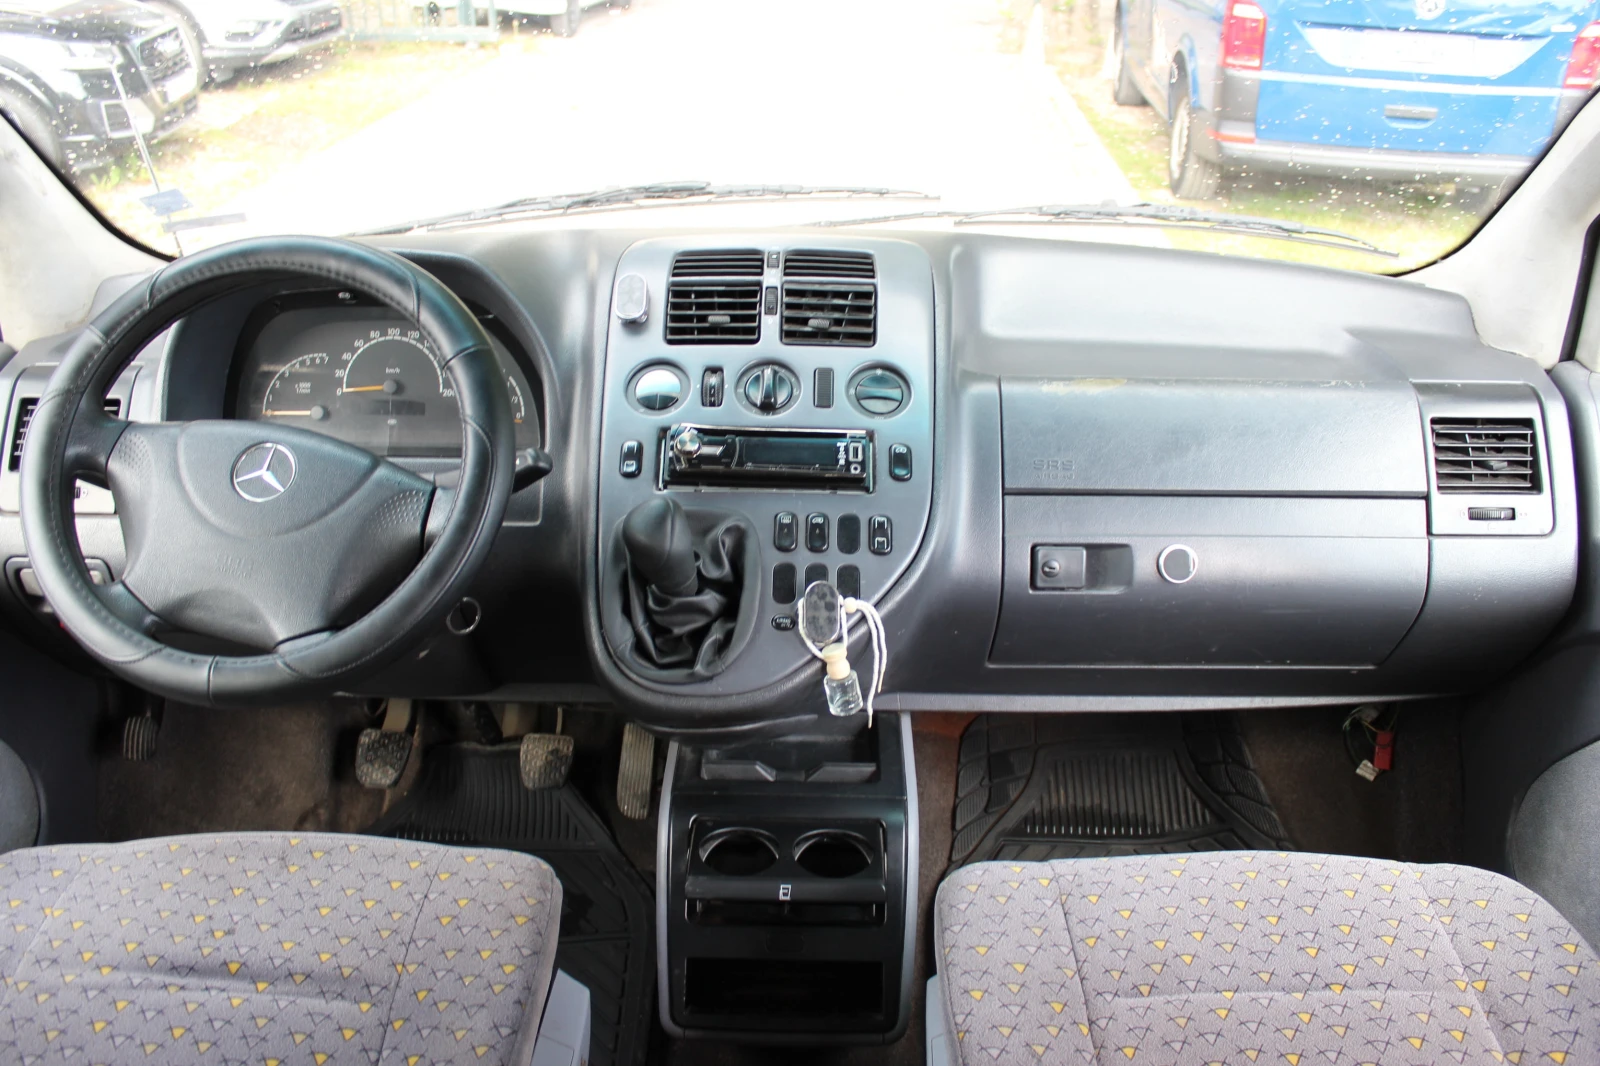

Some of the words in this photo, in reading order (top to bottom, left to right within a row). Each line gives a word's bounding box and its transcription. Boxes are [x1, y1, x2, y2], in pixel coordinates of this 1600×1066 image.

[370, 330, 380, 339] 80
[387, 327, 400, 336] 100
[407, 330, 420, 339] 120
[354, 338, 364, 348] 60
[315, 356, 321, 365] 6
[323, 356, 329, 365] 7
[341, 352, 352, 361] 40
[284, 369, 290, 378] 3
[335, 368, 345, 378] 20
[385, 366, 401, 375] km/h
[274, 380, 281, 389] 2
[336, 387, 342, 396] 0
[1033, 458, 1075, 471] SRS
